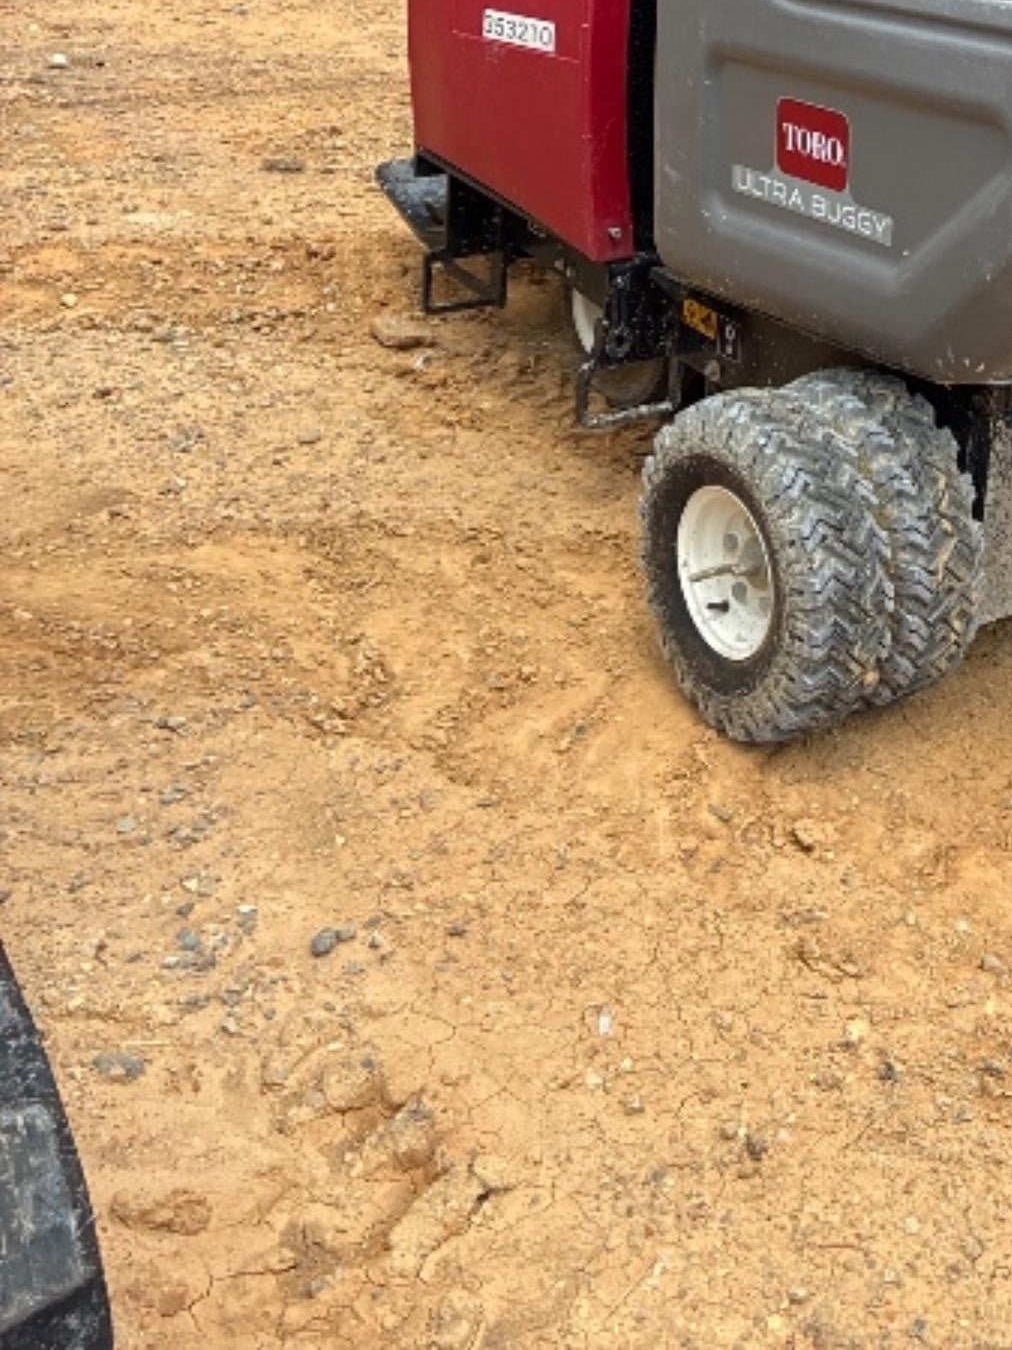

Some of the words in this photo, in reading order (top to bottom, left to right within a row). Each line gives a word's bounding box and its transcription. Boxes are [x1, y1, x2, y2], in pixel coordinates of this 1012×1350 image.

[782, 122, 844, 166] TORO
[734, 169, 804, 211] ULTRA
[811, 193, 891, 236] BUGGY
